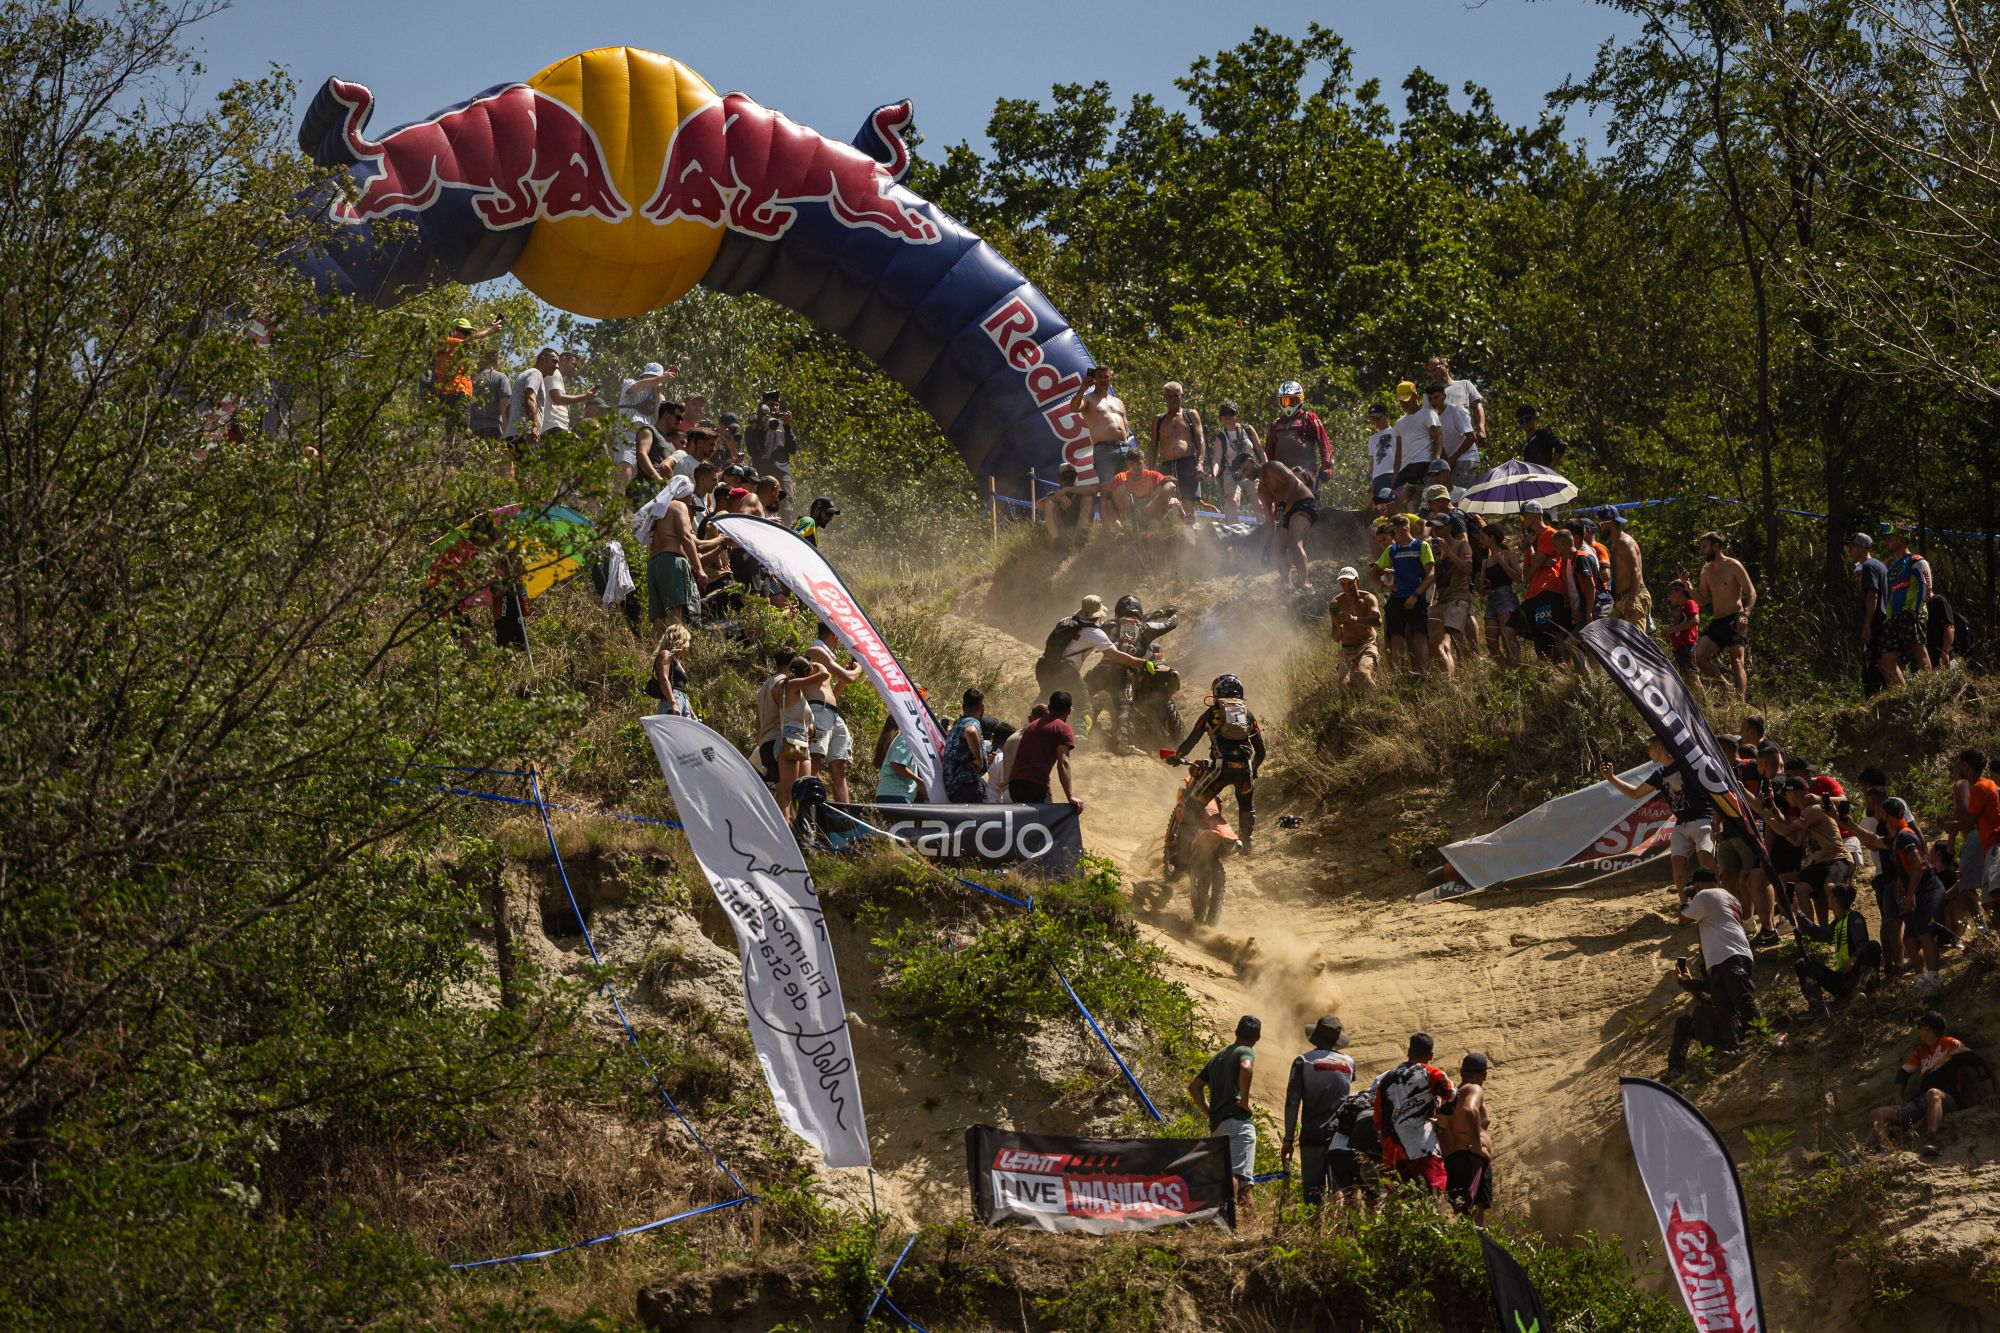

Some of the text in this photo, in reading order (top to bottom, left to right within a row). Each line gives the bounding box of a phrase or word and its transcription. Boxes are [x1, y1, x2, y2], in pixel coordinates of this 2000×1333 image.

[889, 811, 1054, 859] cardo
[1000, 1151, 1062, 1172] LEATT
[1000, 1179, 1184, 1213] LIVE MANIACS
